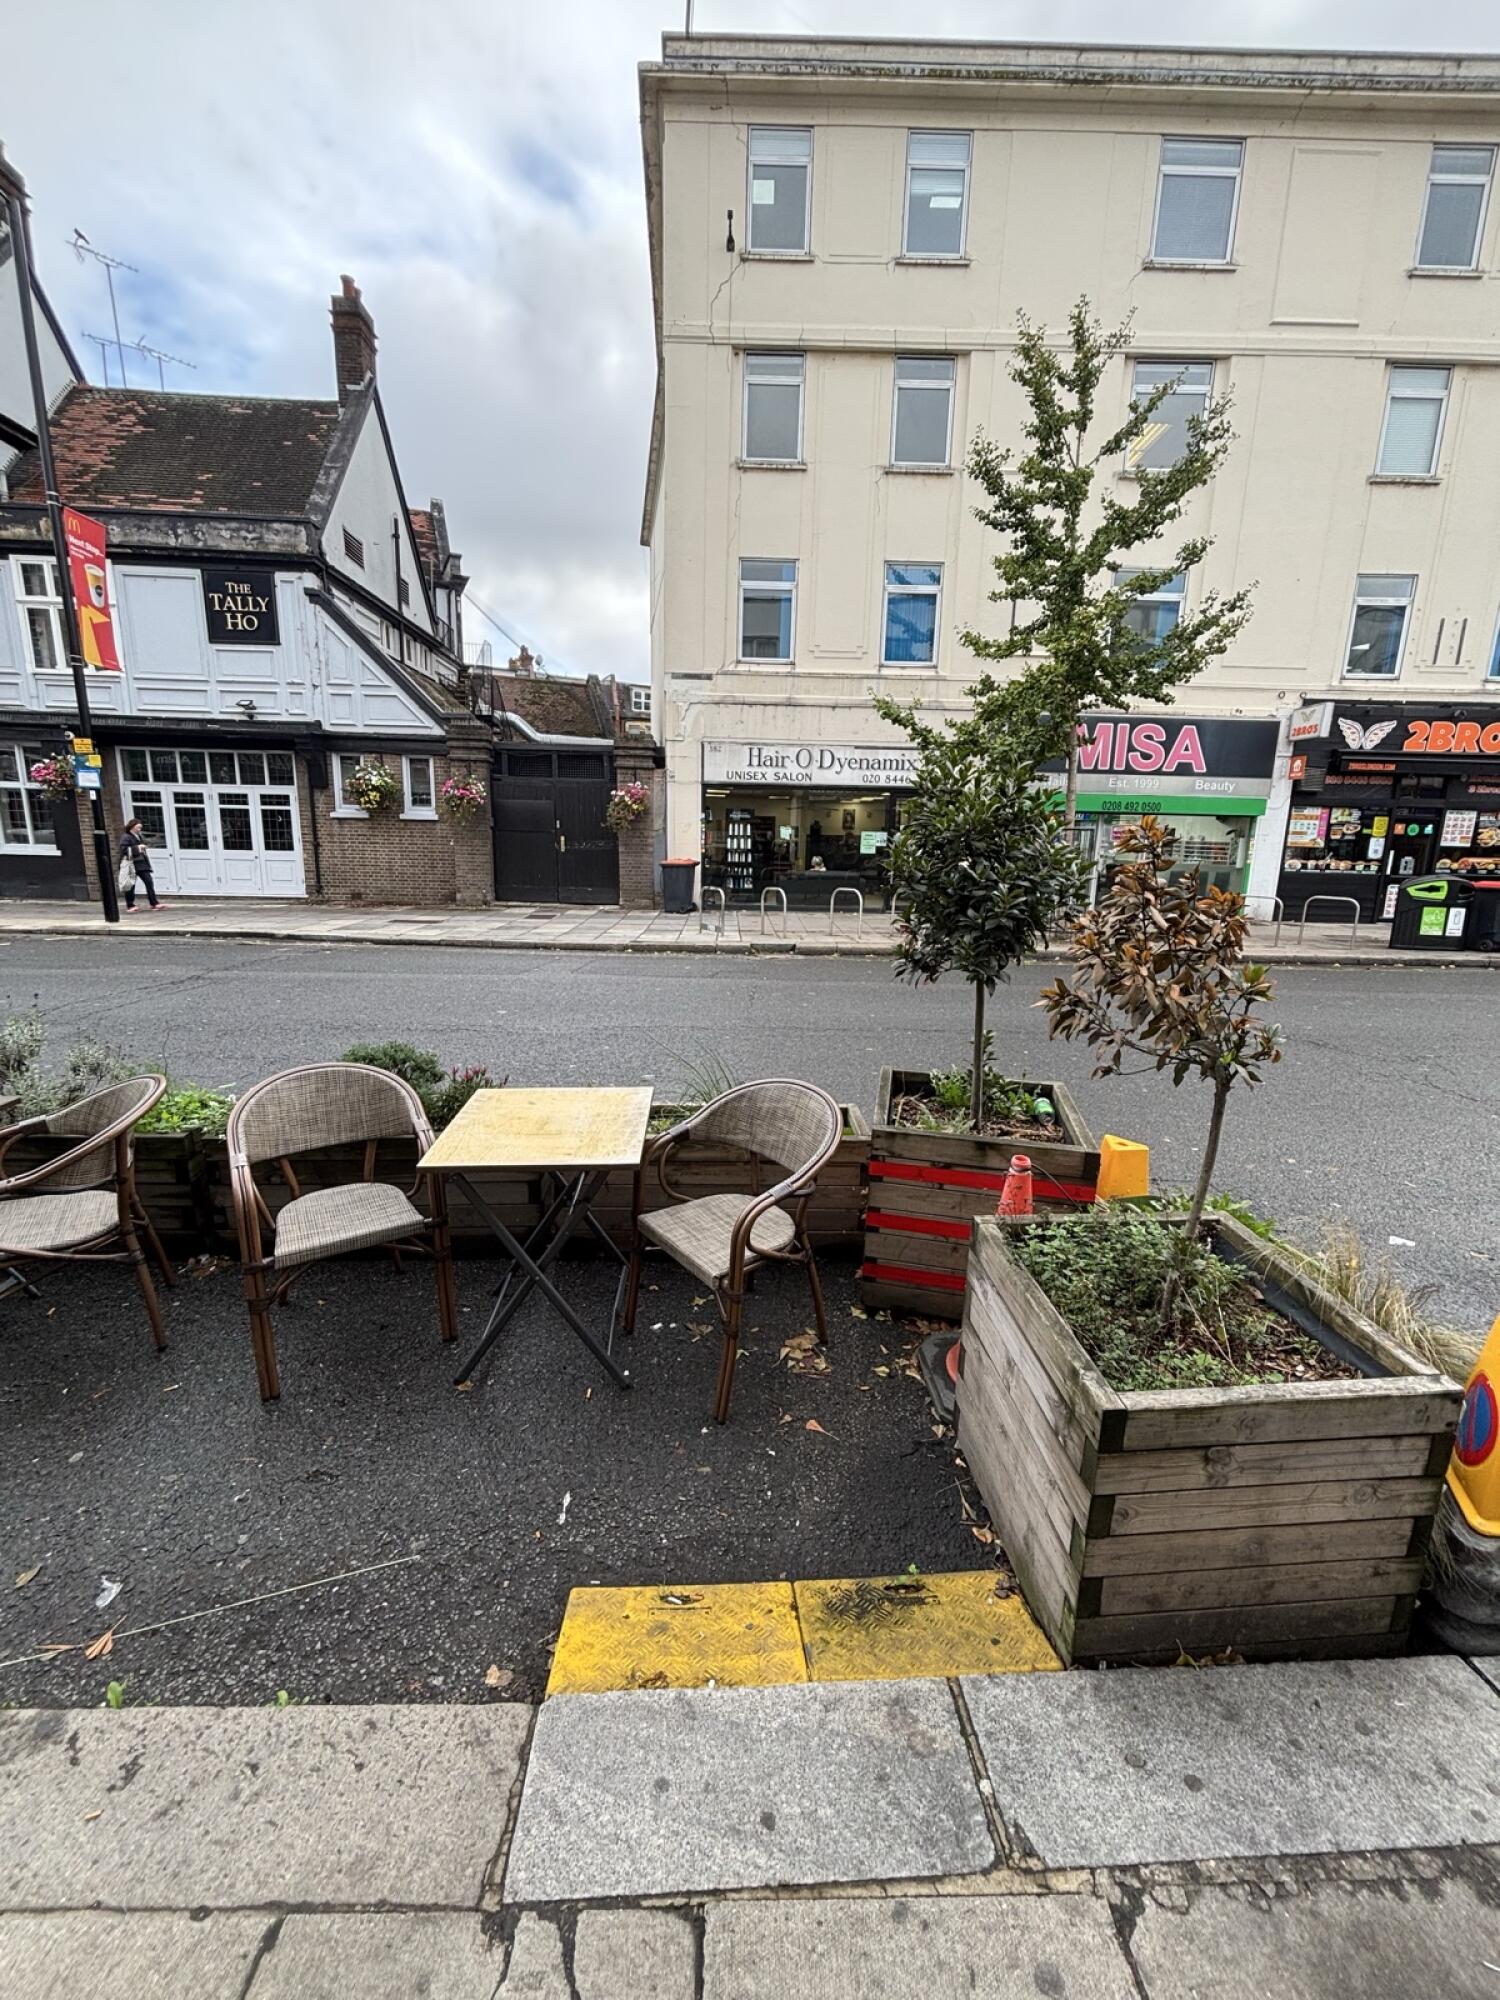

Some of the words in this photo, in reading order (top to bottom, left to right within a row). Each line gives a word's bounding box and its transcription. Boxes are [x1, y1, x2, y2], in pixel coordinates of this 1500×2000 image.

[225, 582, 252, 594] THE
[209, 593, 269, 612] TALLY
[225, 613, 258, 631] HO
[1066, 723, 1207, 773] MISA
[726, 771, 768, 781] UNISEX
[774, 772, 812, 782] SALON
[862, 774, 881, 784] 020
[1135, 778, 1160, 789] 1999
[1195, 780, 1236, 793] Beauty
[1102, 801, 1122, 811] 0208
[1124, 802, 1140, 812] 492
[1141, 802, 1162, 812] 0500
